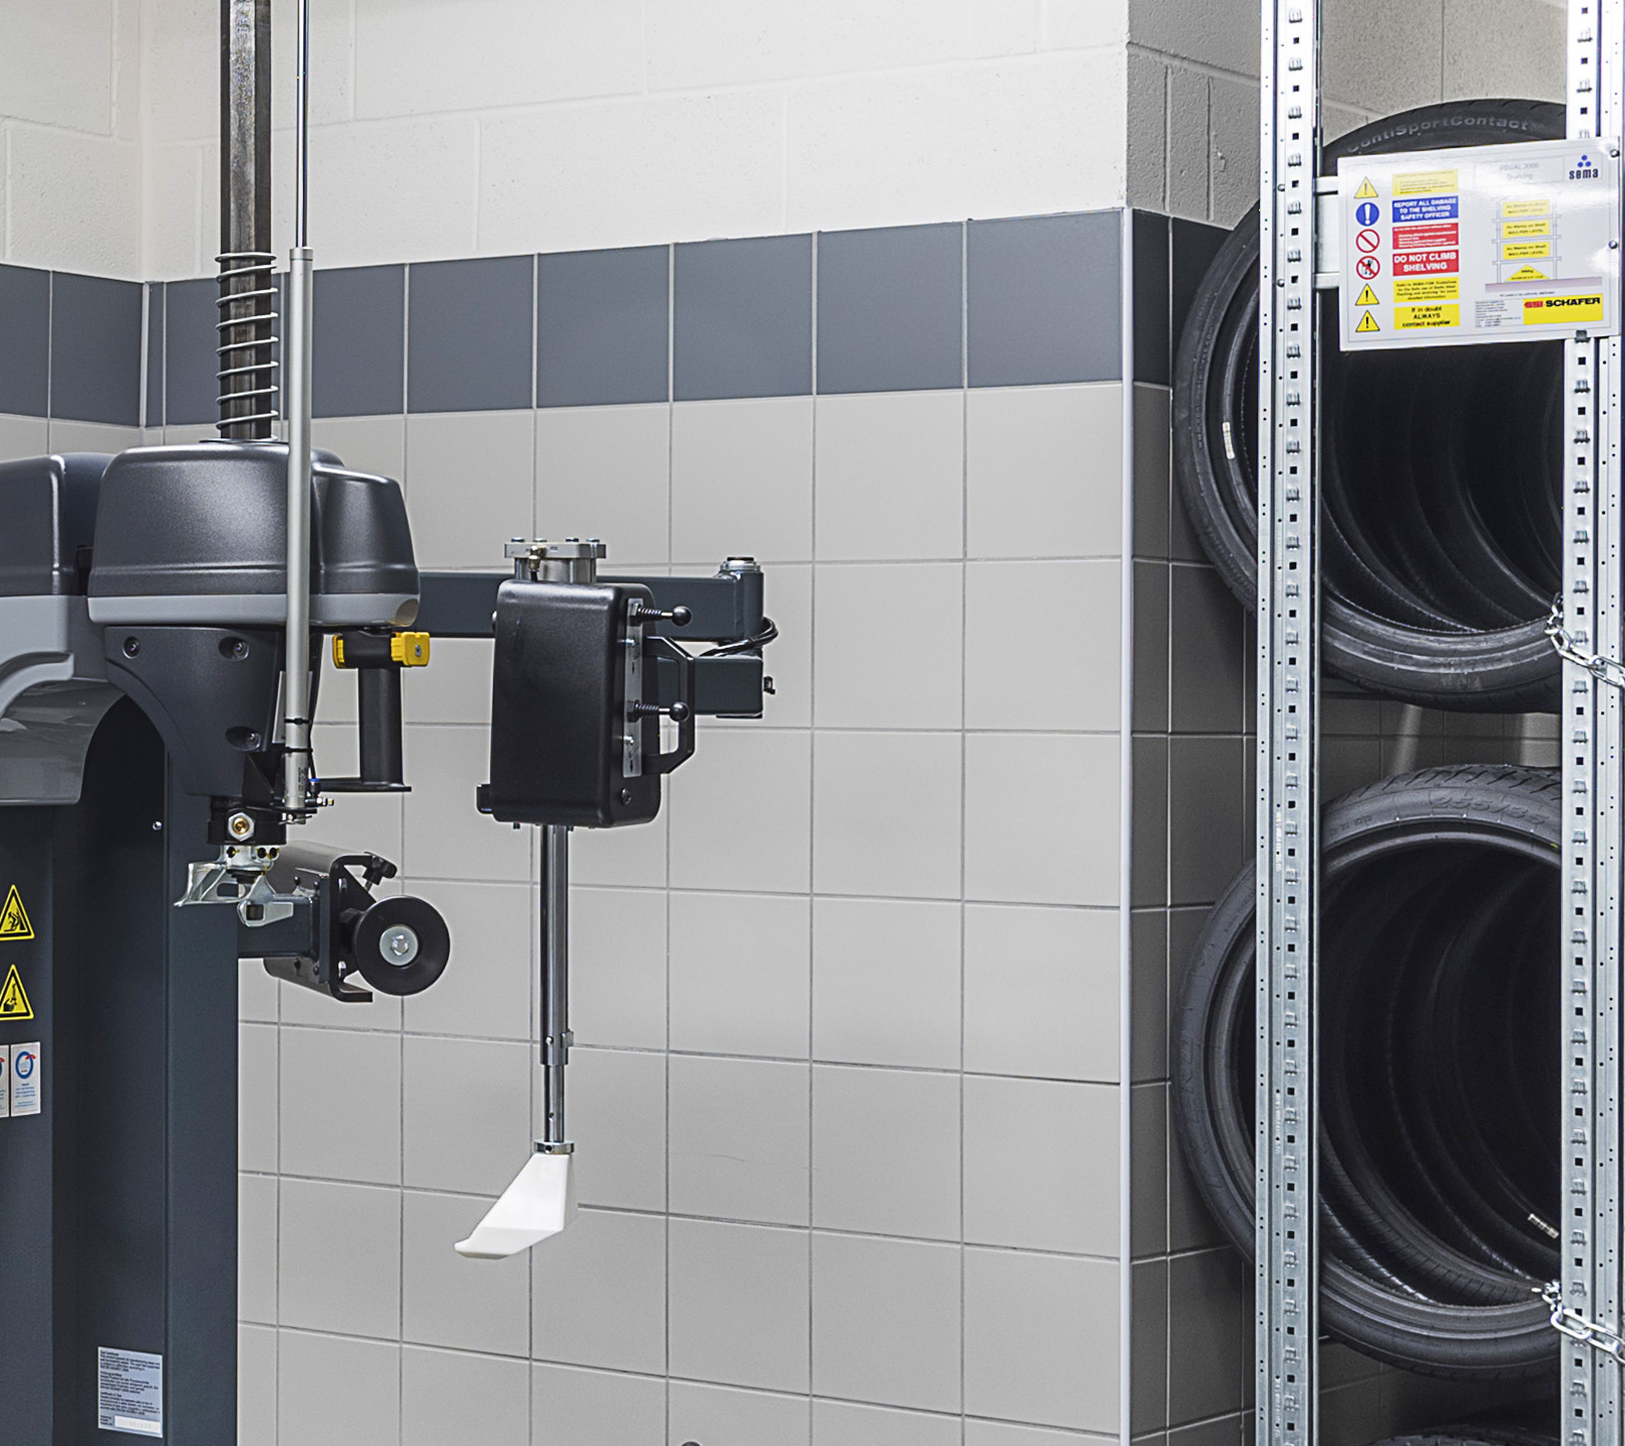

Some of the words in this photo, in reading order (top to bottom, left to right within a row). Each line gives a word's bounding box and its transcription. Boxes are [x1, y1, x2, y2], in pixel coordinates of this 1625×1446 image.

[1347, 116, 1528, 153] ContiSportContact
[1568, 168, 1599, 180] sema
[1393, 200, 1418, 208] REPORT
[1421, 205, 1451, 213] SHELVING
[1400, 213, 1423, 221] SAFETY
[1424, 211, 1450, 219] OFFICER
[1393, 255, 1408, 263] DO
[1409, 253, 1428, 262] NOT
[1428, 251, 1457, 261] CLIMB
[1403, 262, 1448, 272] SHELVING
[1413, 312, 1441, 320] ALWAYS
